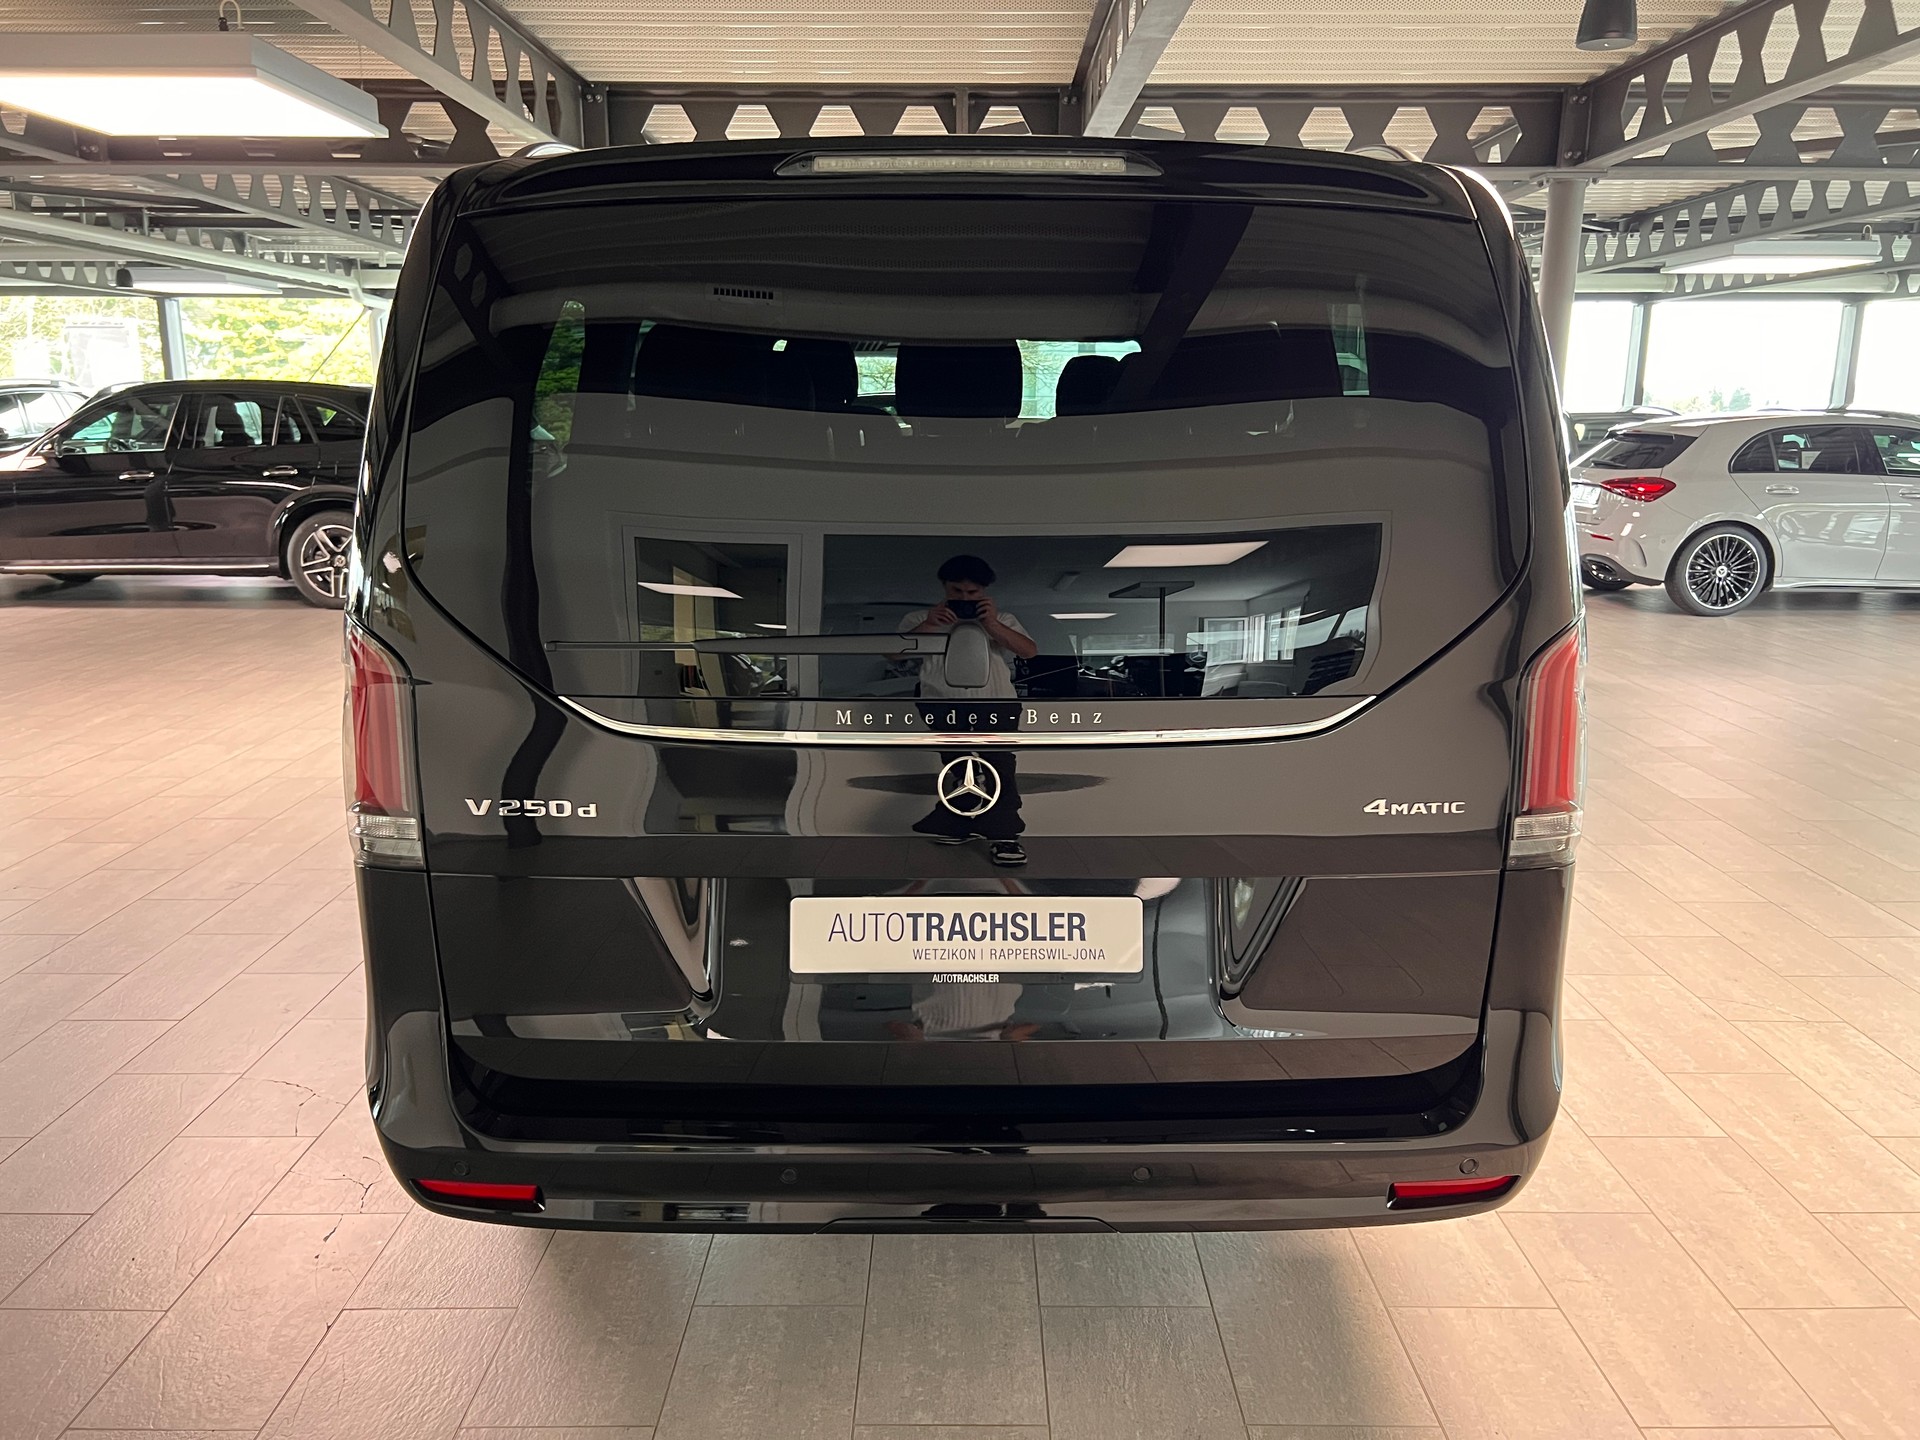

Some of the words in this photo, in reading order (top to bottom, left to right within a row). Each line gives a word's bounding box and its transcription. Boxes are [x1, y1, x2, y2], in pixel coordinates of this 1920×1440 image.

[836, 709, 1103, 725] Mercedes-Benz
[465, 799, 492, 816] V
[1363, 799, 1466, 816] 4MATIC
[828, 912, 1087, 942] AUTOTRACHSLER
[913, 949, 976, 960] WETZIKON
[989, 949, 1106, 960] RAPPERSWIL-JONA
[932, 974, 1000, 983] AUTOTRACHSLER
